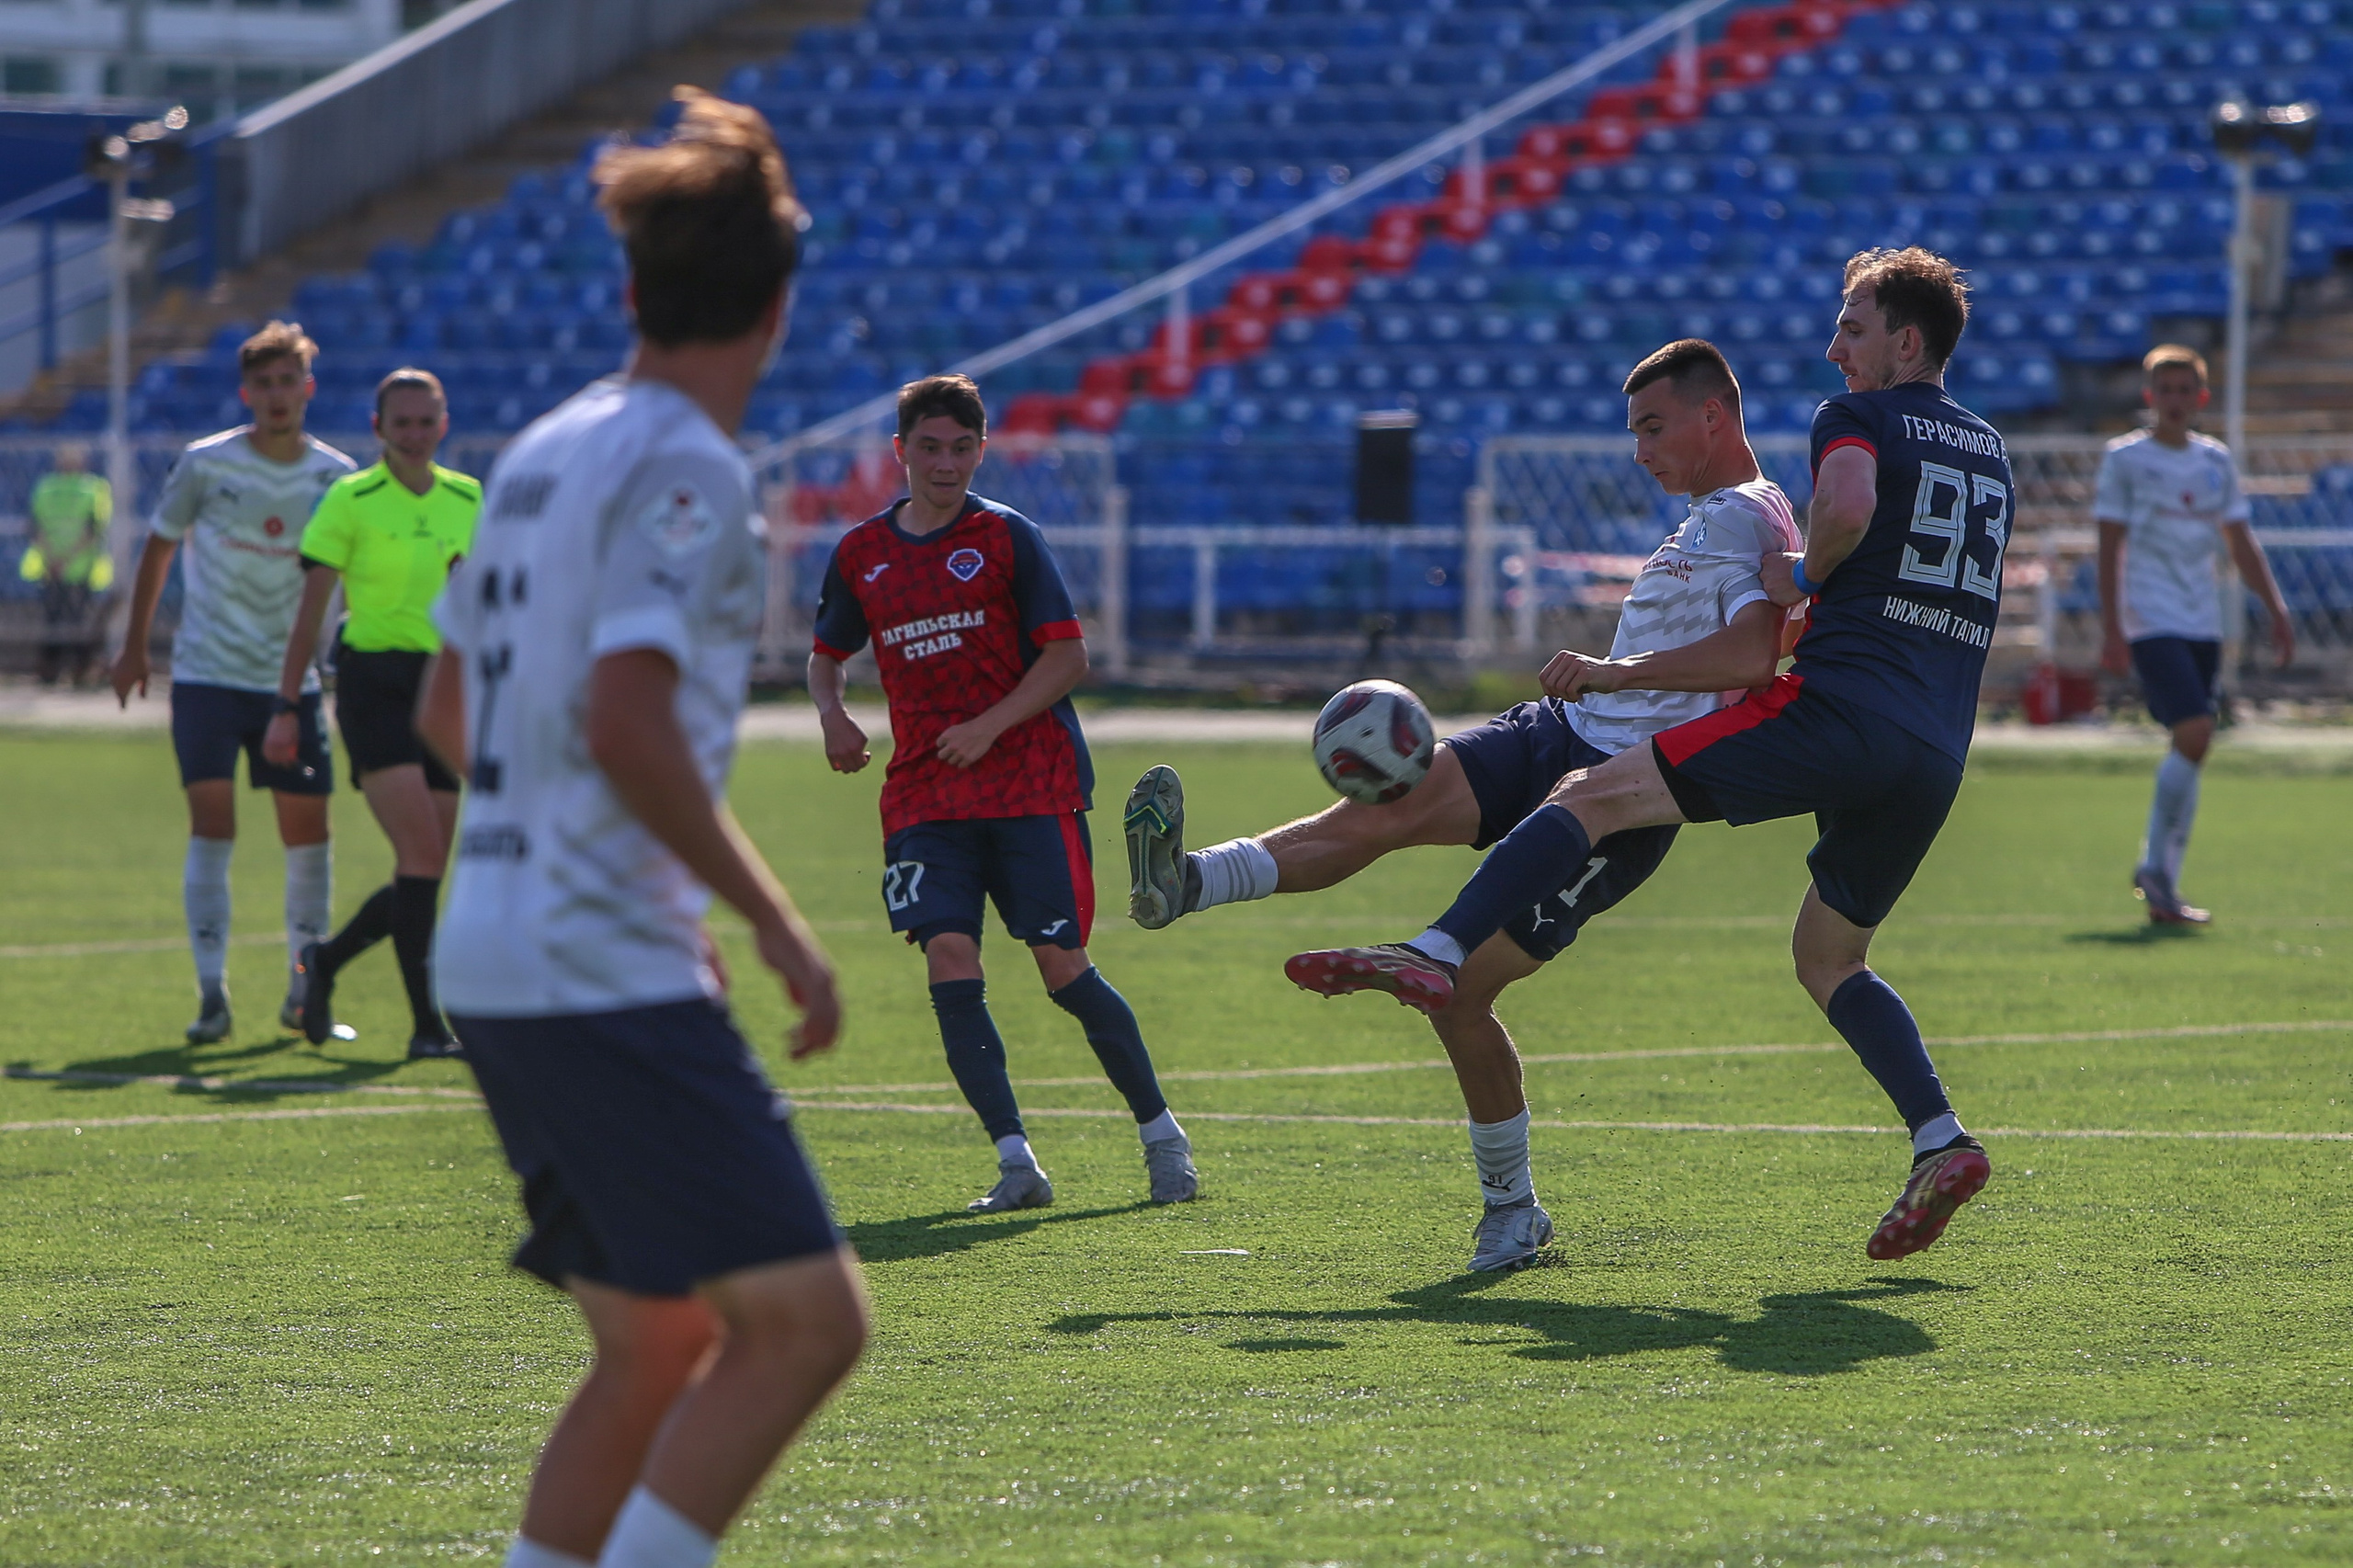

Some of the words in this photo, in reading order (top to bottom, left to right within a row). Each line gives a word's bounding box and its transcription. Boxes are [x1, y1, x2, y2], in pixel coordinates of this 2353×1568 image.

[1898, 460, 2007, 602] 93
[904, 631, 962, 661] СТАЛЬ
[1882, 596, 1951, 634] НИЖНИЙ
[1950, 615, 1990, 650] ТАГИЛ
[886, 860, 925, 912] 27
